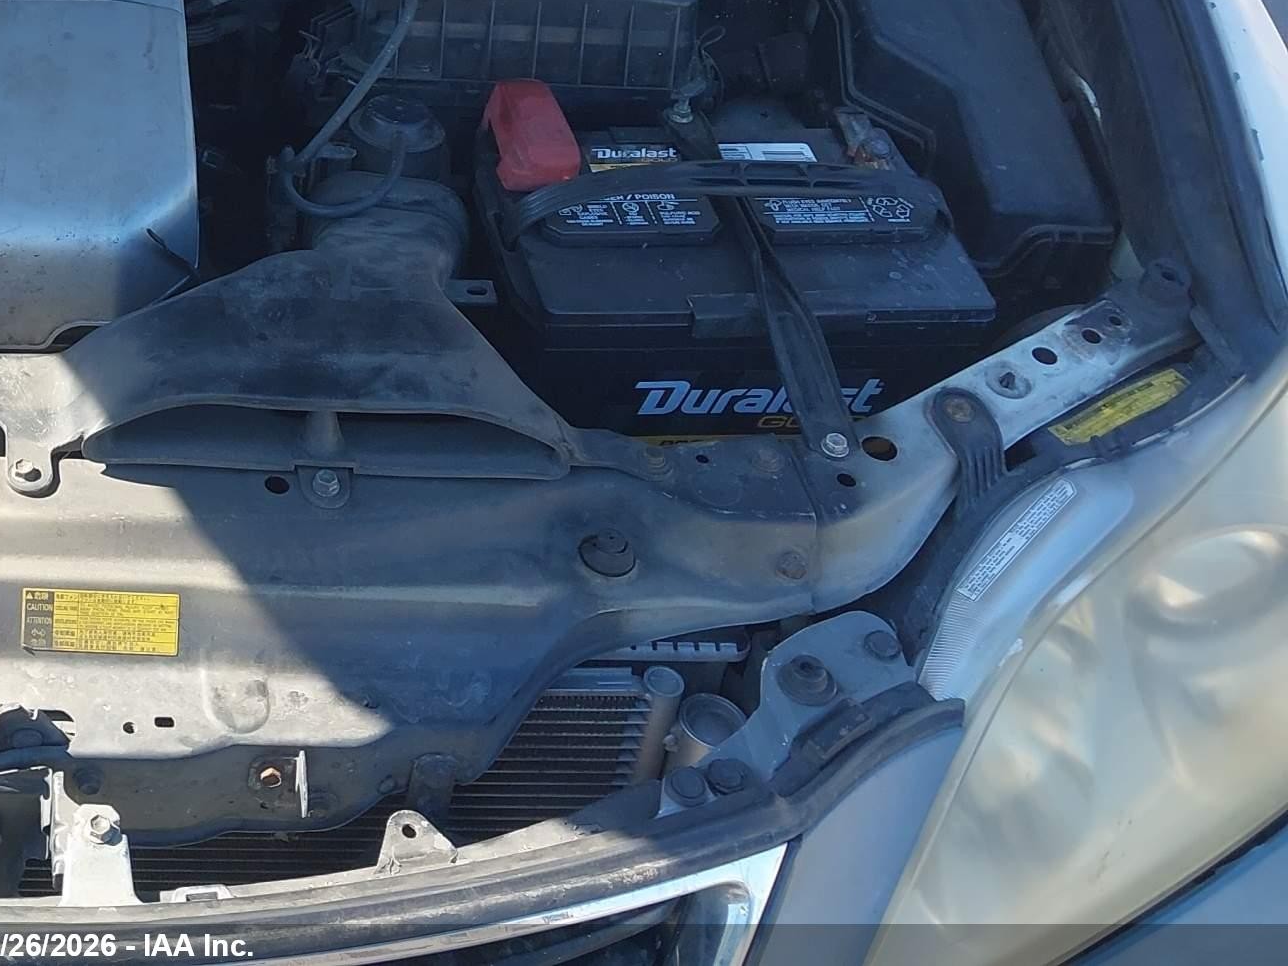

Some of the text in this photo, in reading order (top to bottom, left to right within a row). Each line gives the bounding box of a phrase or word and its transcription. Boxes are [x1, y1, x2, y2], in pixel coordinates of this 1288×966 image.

[591, 147, 678, 160] Duralast
[635, 378, 883, 415] Duralt
[26, 602, 54, 612] CAUTION
